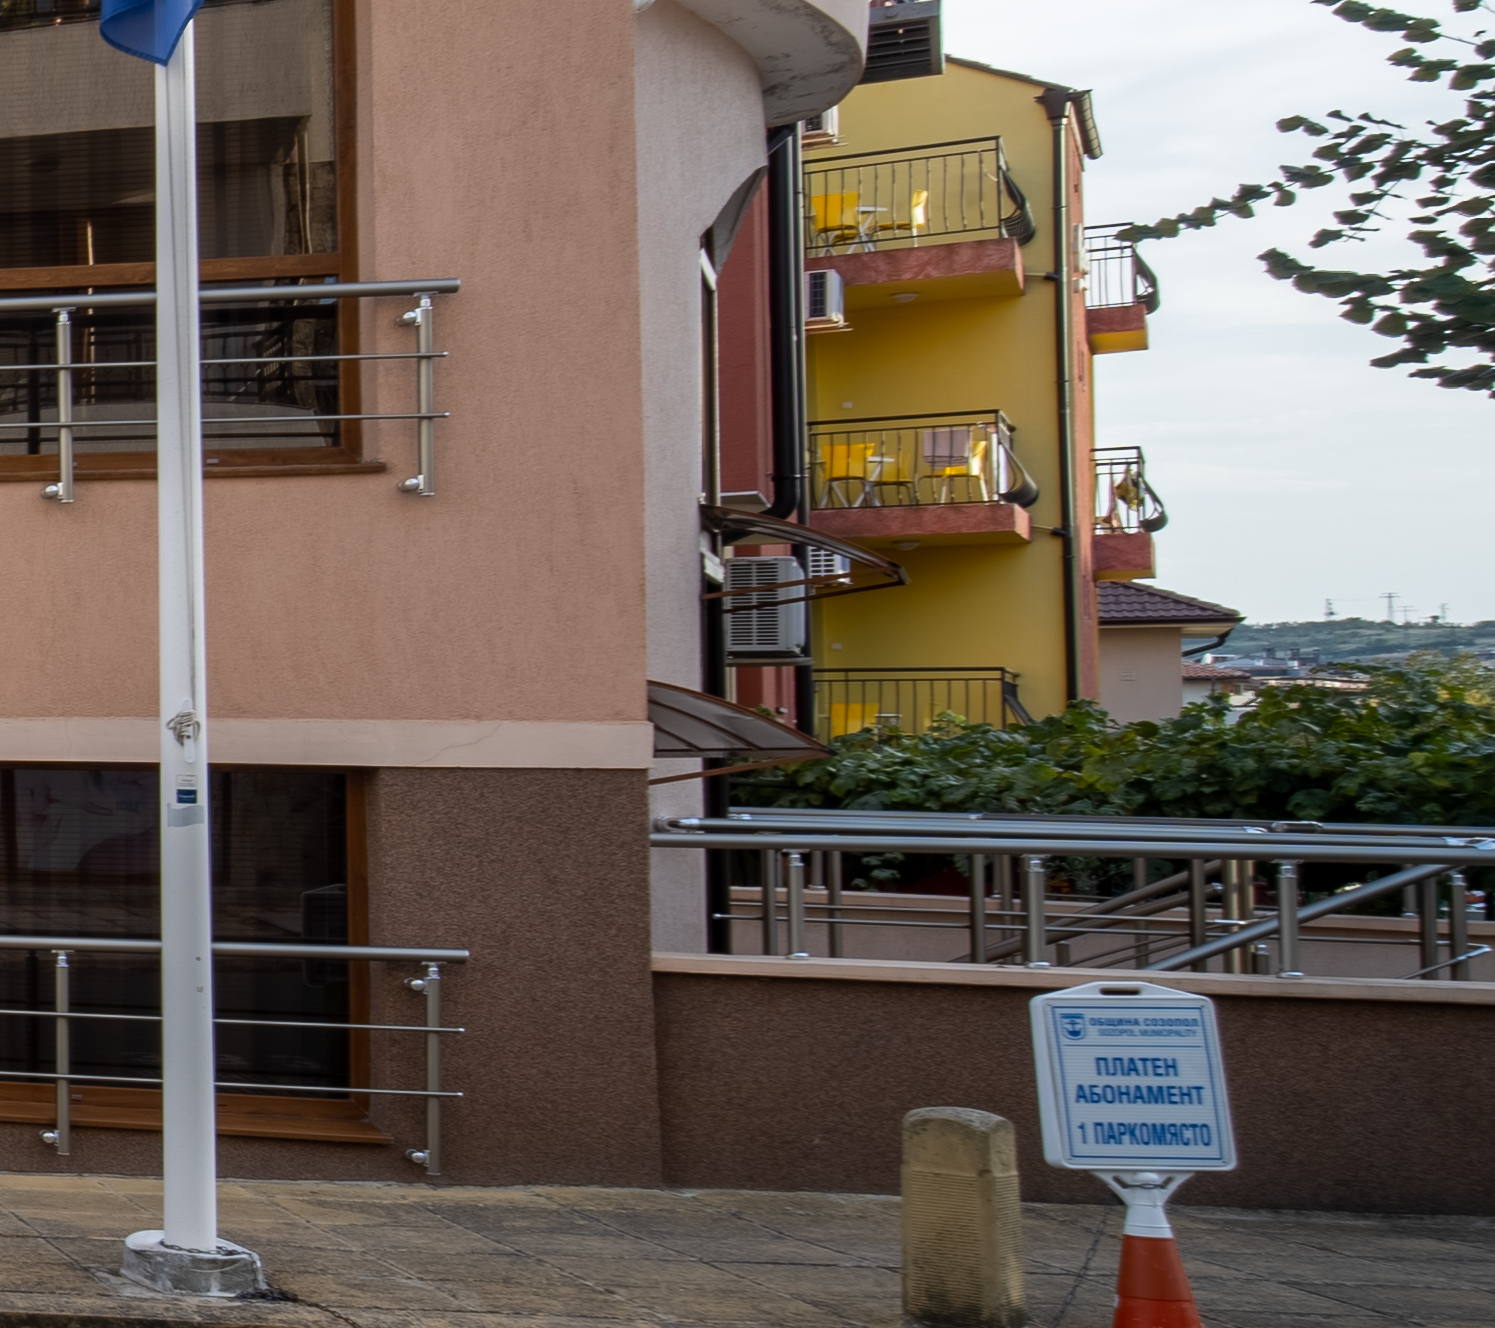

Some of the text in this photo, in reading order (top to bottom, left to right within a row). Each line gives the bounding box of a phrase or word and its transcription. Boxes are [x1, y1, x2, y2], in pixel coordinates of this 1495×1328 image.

[1089, 1017, 1200, 1028] ОБЩИНА СОЗОПОЛ
[1098, 1028, 1197, 1038] SOZOPOL MUNICIPALITY
[1094, 1056, 1179, 1077] ПЛАТЕН
[1075, 1084, 1205, 1105] АБОНАМЕНТ
[1077, 1122, 1212, 1146] 1 ПАРКОМЯСТО
